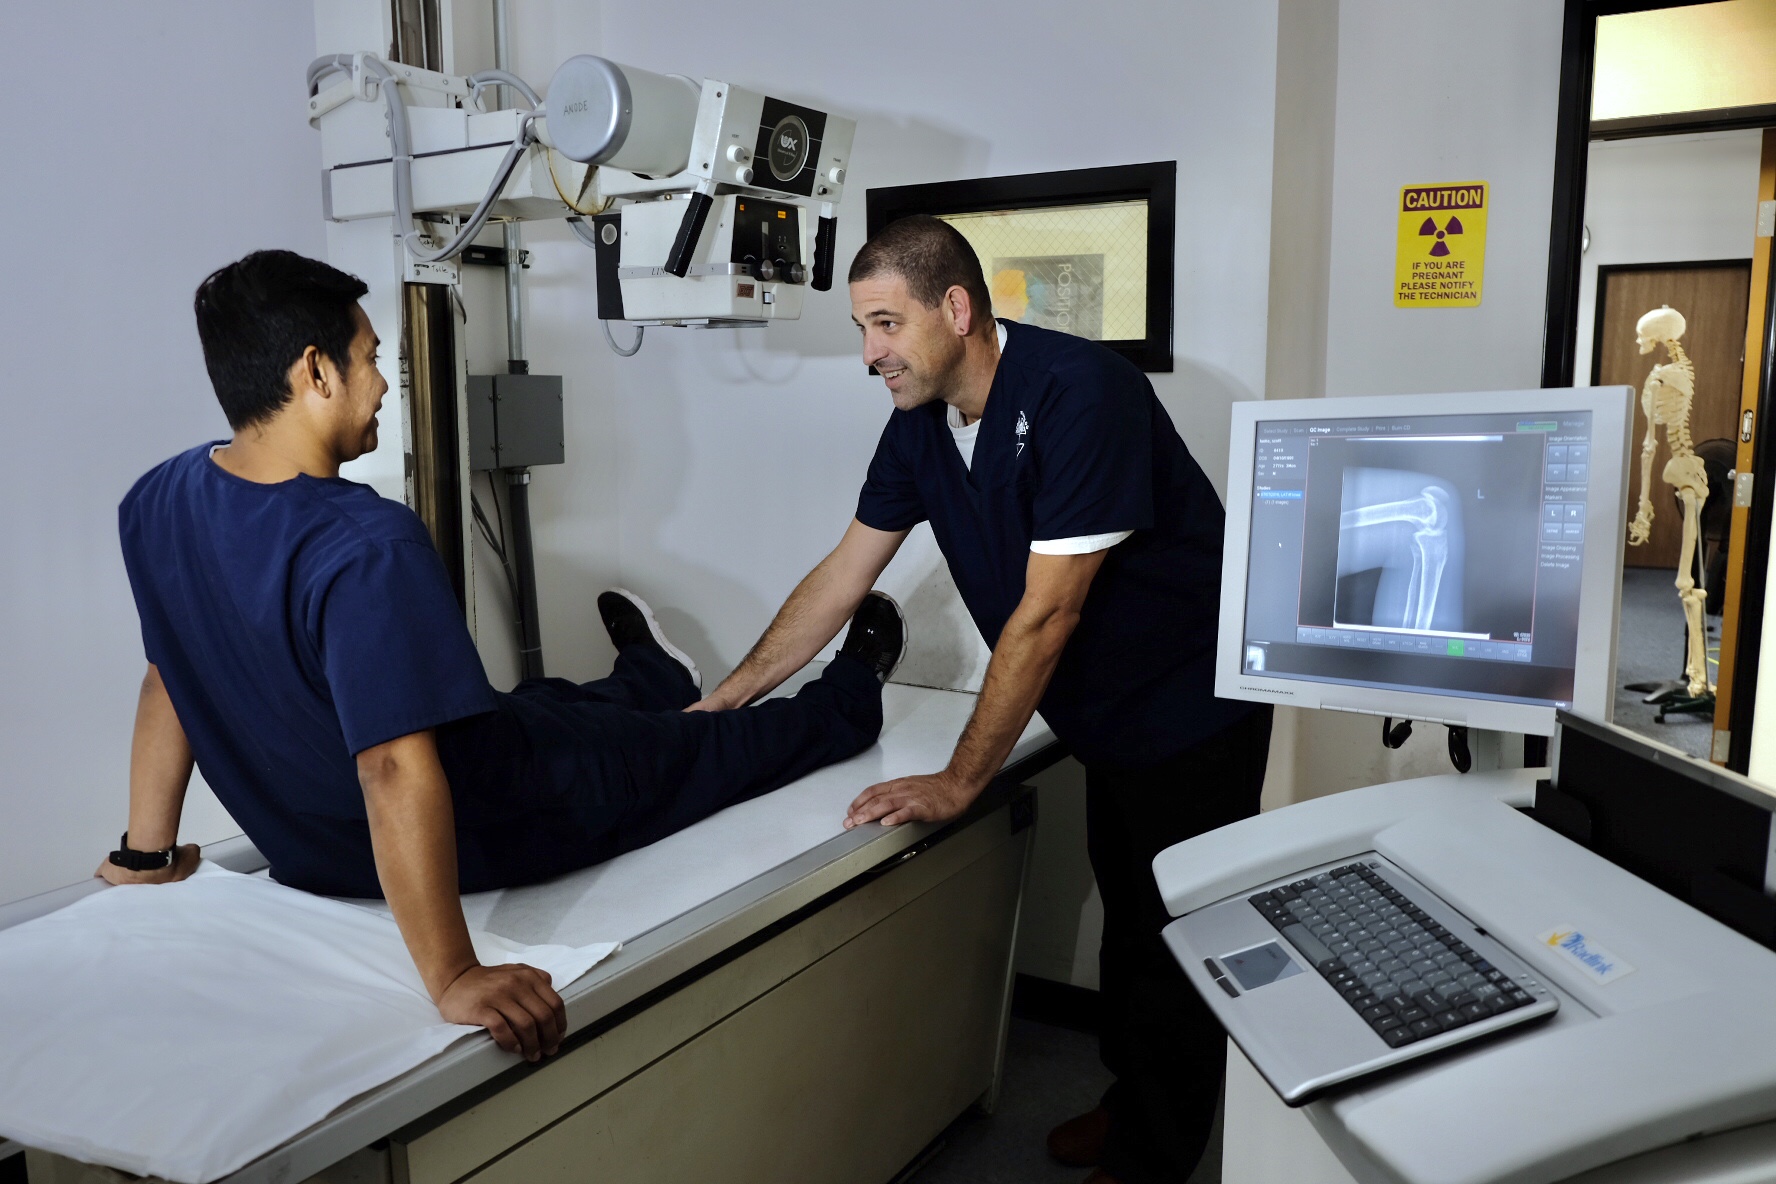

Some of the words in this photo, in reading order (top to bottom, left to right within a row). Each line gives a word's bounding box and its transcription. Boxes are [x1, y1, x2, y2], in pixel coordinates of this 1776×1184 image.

[563, 100, 588, 116] ANODE
[1405, 189, 1482, 208] CAUTION
[1412, 262, 1421, 270] IF
[1424, 261, 1443, 270] YOU
[1445, 260, 1465, 269] ARE
[1412, 271, 1464, 280] PREGNANT
[1401, 282, 1437, 290] PLEASE
[1440, 281, 1475, 290] NOTIFY
[1398, 292, 1416, 300] THE
[1419, 291, 1477, 300] TECHNICIAN
[1477, 489, 1485, 499] L
